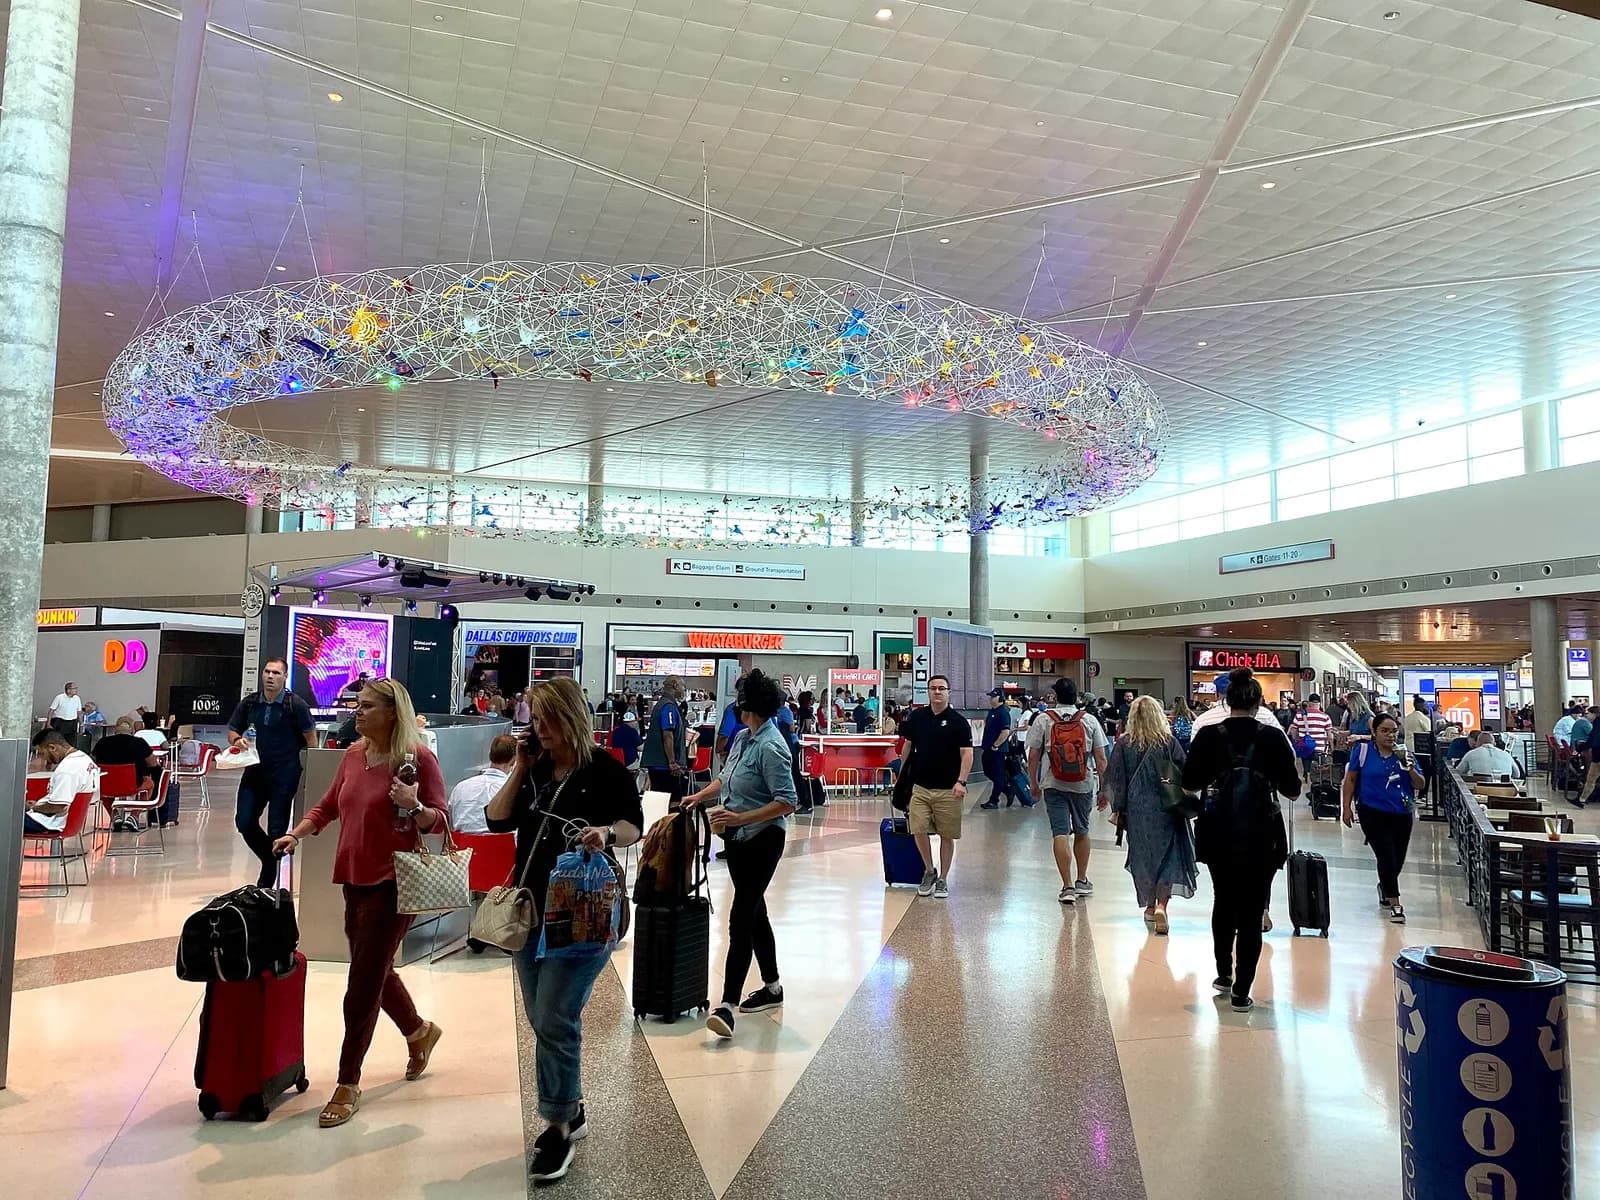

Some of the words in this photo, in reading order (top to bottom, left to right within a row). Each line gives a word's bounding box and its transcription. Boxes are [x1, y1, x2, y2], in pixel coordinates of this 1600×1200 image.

[1263, 554, 1281, 563] Gates
[1282, 550, 1299, 560] 11-20
[691, 563, 715, 571] Baggage
[765, 567, 802, 575] Transportation
[465, 630, 502, 642] DALLAS
[503, 630, 552, 643] COWBOYS
[552, 632, 578, 644] CLUB
[687, 632, 785, 650] WHATABURGER
[104, 639, 148, 673] DD
[1215, 651, 1281, 668] Chick-fil-A
[1572, 650, 1586, 659] 12
[862, 673, 878, 681] CART
[192, 699, 220, 711] 100%
[1400, 1062, 1417, 1200] ECYCLE
